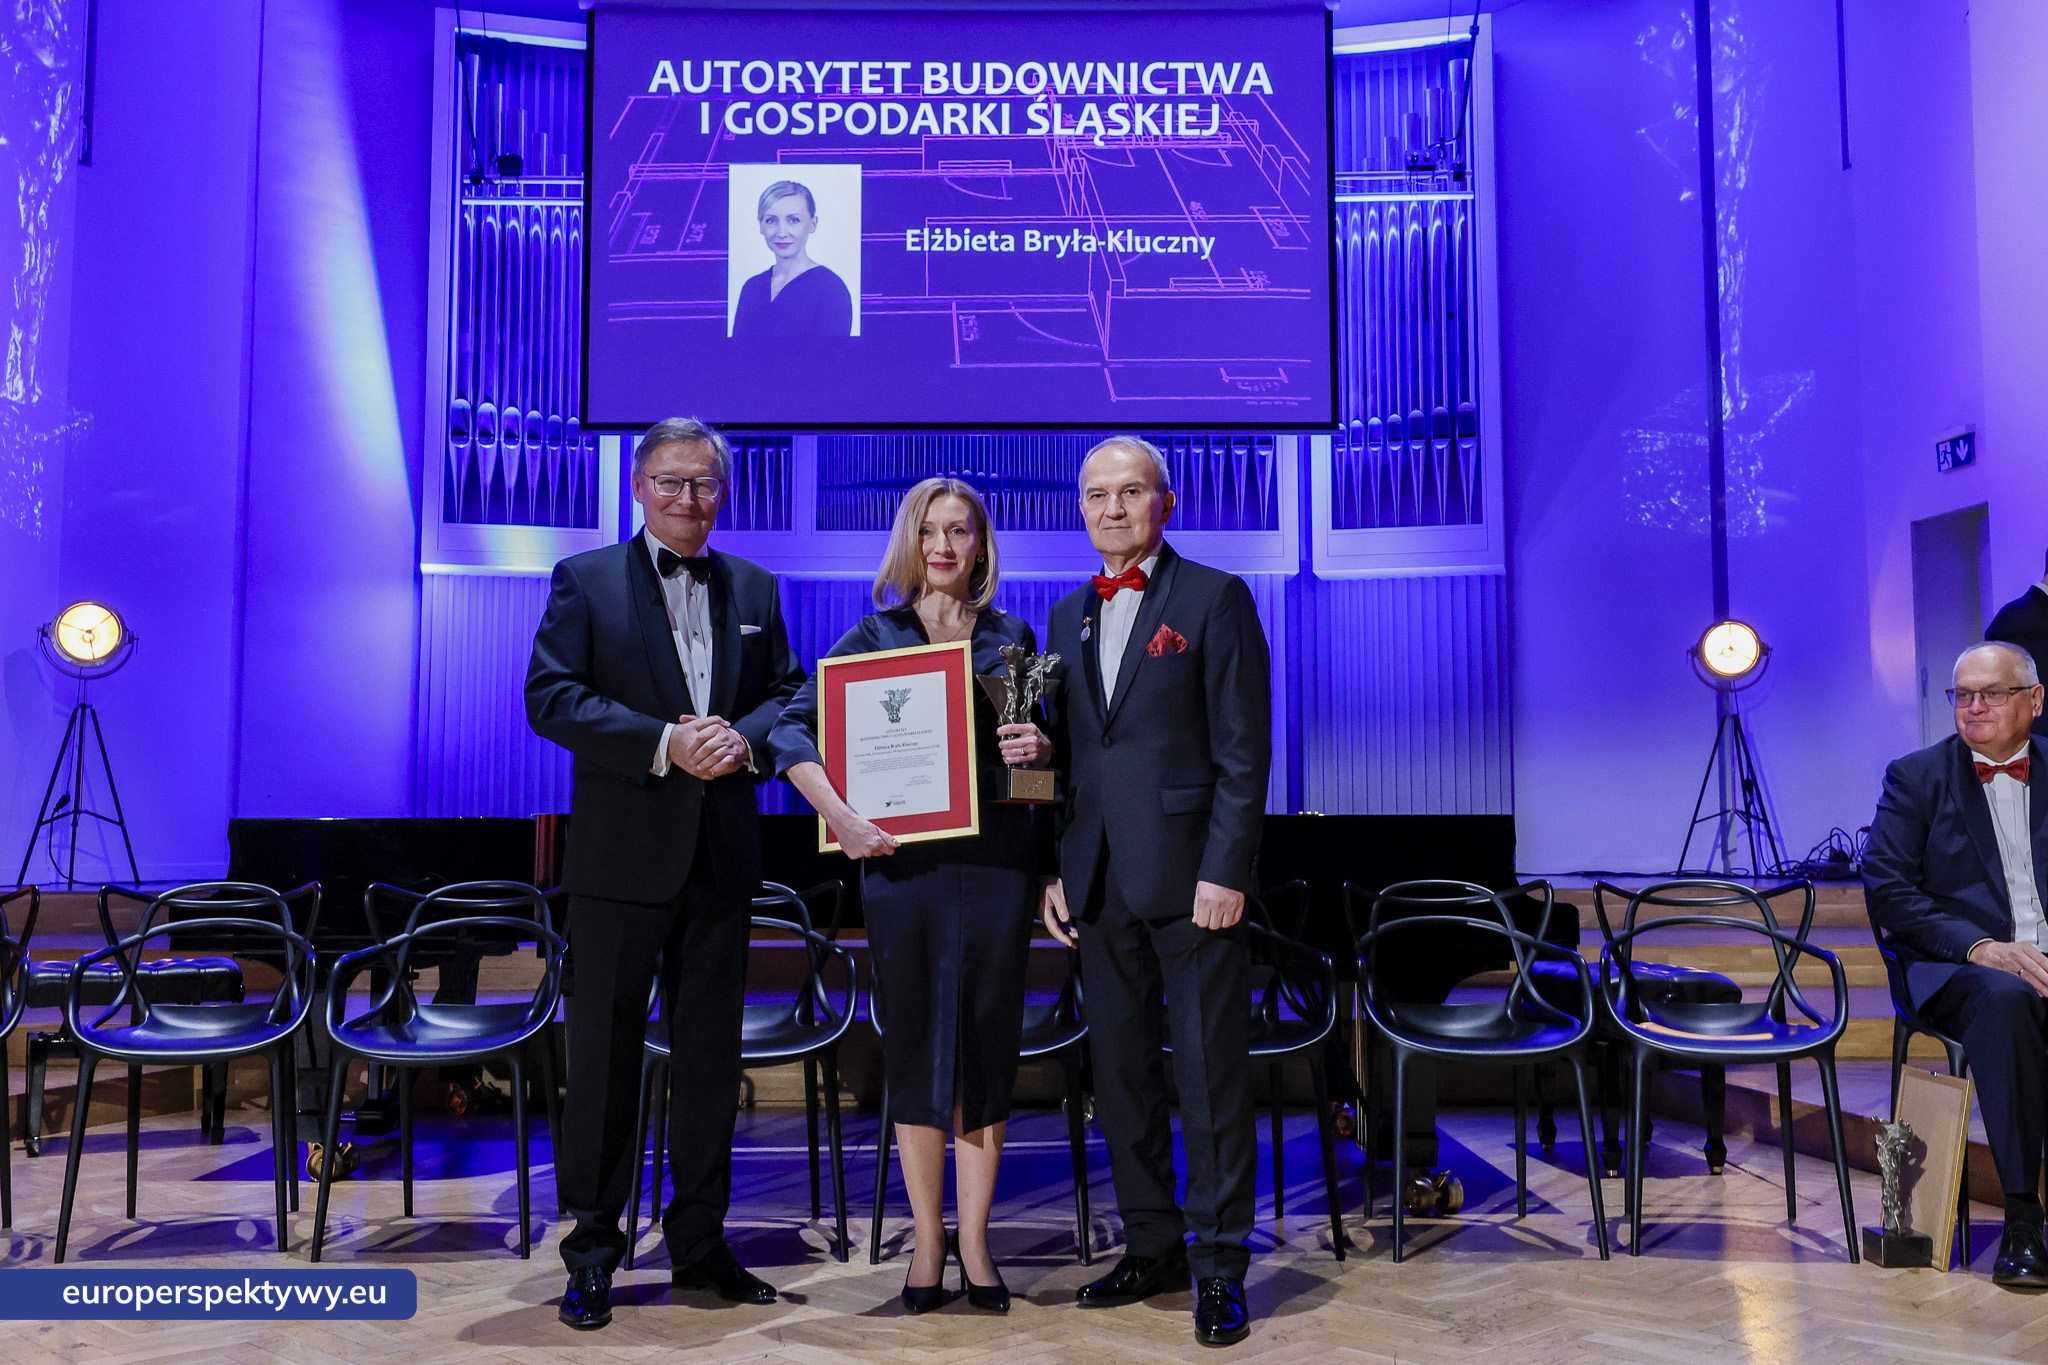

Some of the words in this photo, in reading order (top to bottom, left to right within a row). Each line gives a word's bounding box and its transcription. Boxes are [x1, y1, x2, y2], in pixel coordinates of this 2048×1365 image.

[648, 60, 911, 95] AUTORYTET
[923, 61, 1274, 96] BUDOWNICTWA
[700, 102, 710, 134] I
[725, 101, 1010, 136] GOSPODARKI
[1025, 95, 1221, 146] ŚLĄSKIEJ
[905, 227, 1015, 253] Elżbieta
[1024, 228, 1216, 260] Bryła-Kluczny
